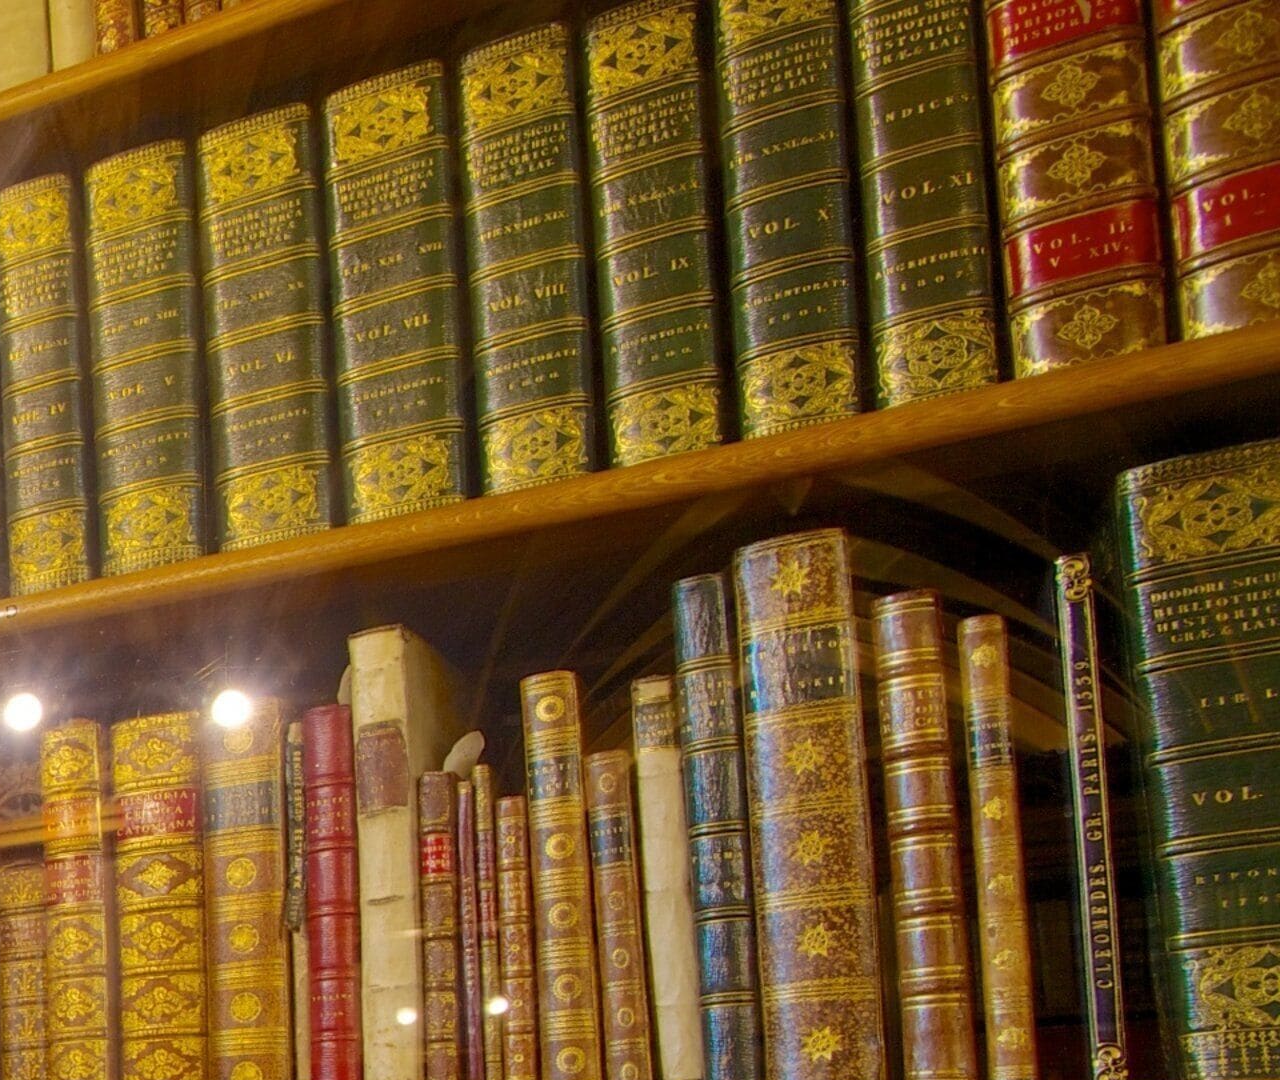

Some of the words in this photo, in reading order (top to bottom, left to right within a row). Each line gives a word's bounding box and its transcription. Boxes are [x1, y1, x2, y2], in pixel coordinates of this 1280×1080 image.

[1033, 232, 1090, 255] VOL.
[1109, 221, 1135, 235] II.
[1150, 579, 1225, 603] DIODORI
[1233, 572, 1280, 589] SICU
[1153, 590, 1280, 619] BIBLIOTHE
[1156, 604, 1276, 633] HISTORIC
[1192, 785, 1264, 806] VOL.
[1195, 867, 1278, 885] BIPON
[1089, 859, 1113, 990] CLEOMEDES.
